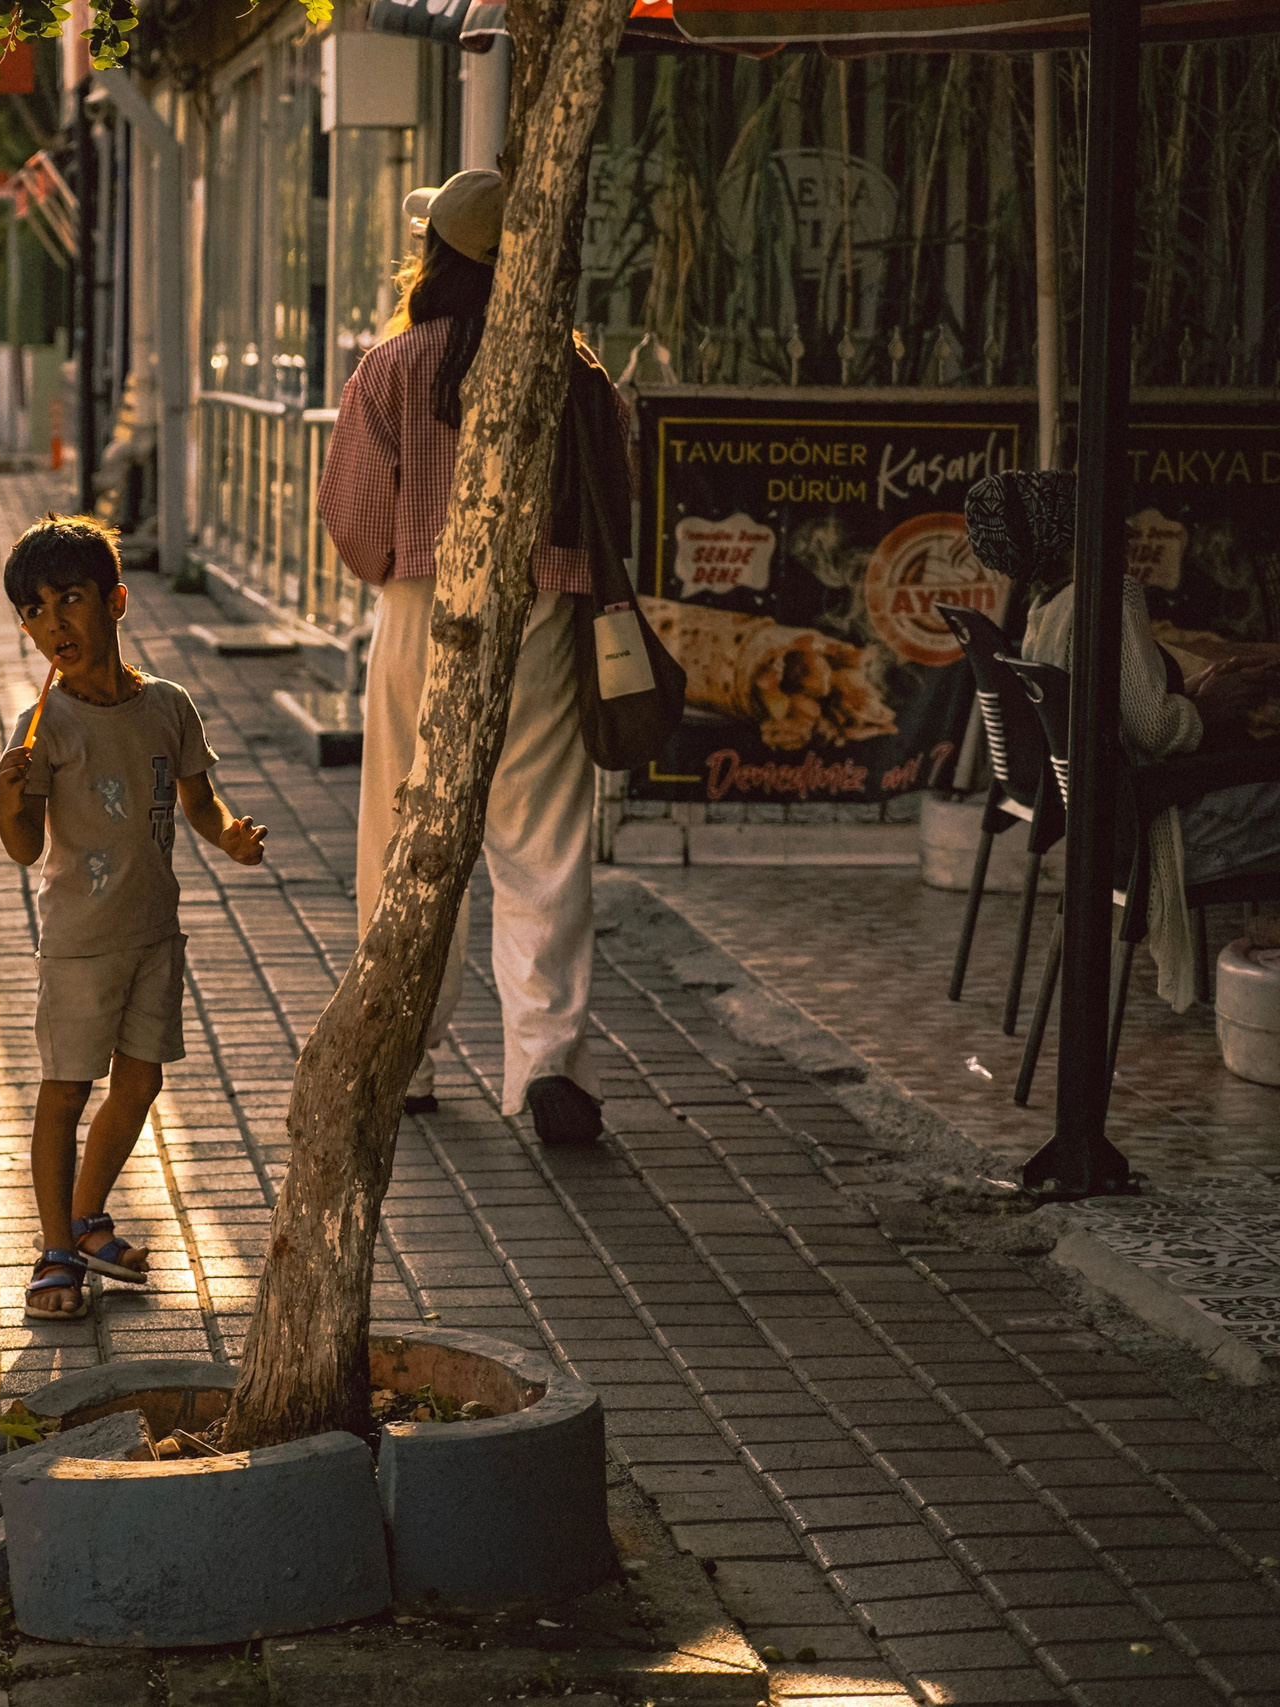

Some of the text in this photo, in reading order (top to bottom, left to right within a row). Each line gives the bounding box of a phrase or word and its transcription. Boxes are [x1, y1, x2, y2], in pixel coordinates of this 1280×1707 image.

[670, 437, 868, 466] TAVUK DÖNER
[1127, 450, 1252, 484] TAKYA
[768, 473, 868, 503] DÜRÜM
[693, 546, 756, 564] SENDE
[693, 566, 742, 586] DENE
